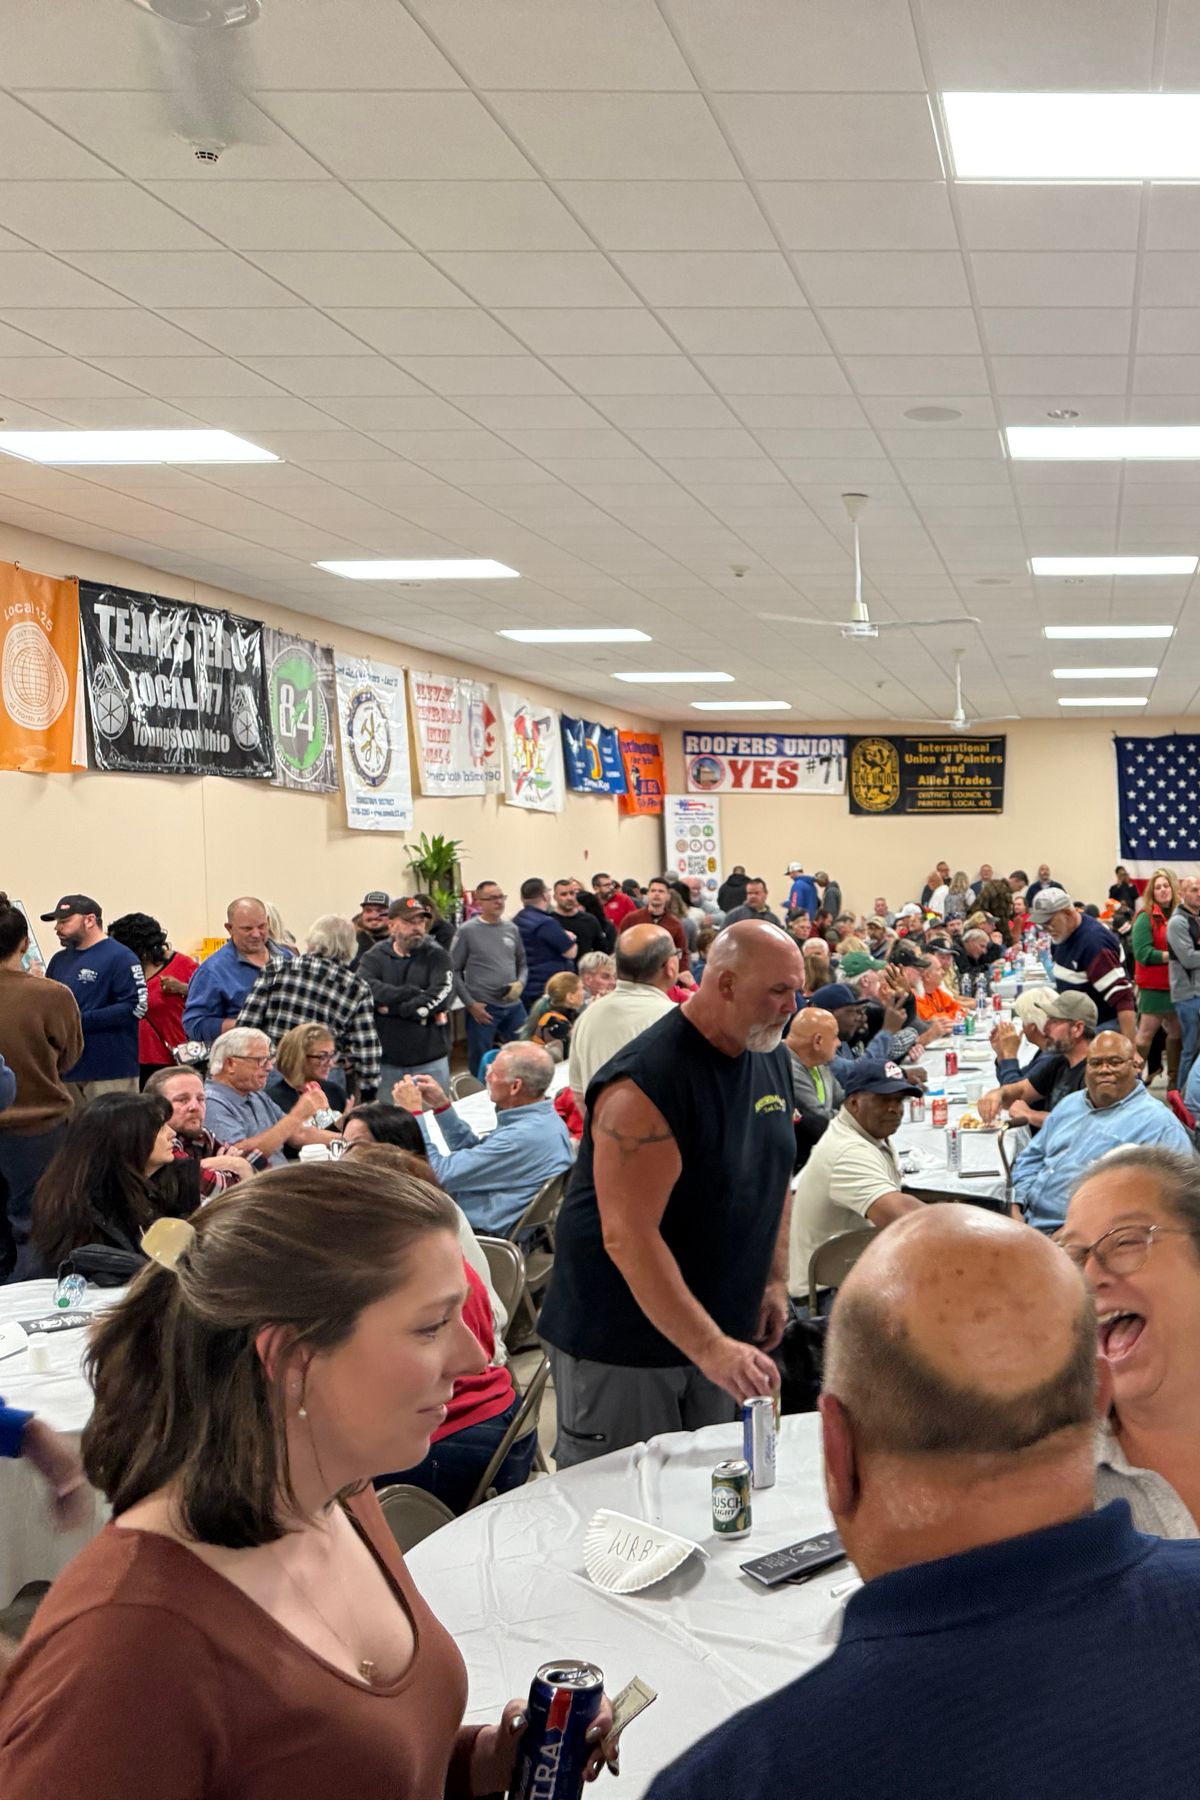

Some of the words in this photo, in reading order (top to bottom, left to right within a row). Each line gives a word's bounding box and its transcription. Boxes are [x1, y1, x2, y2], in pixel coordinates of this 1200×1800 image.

[4, 602, 34, 621] Local
[35, 607, 53, 632] 125
[130, 671, 199, 711] LOCAL
[203, 729, 231, 754] Ohio
[685, 735, 778, 754] ROOFERS
[784, 739, 845, 756] UNION
[918, 743, 990, 753] International
[905, 754, 936, 764] Union
[940, 754, 951, 764] of
[956, 754, 1003, 764] Painters
[728, 760, 800, 789] YES
[944, 764, 965, 774] and
[918, 775, 949, 785] Allied
[954, 775, 993, 785] Trades
[952, 791, 983, 799] COUNCIL
[130, 964, 147, 986] BUY
[712, 1496, 743, 1510] USCH
